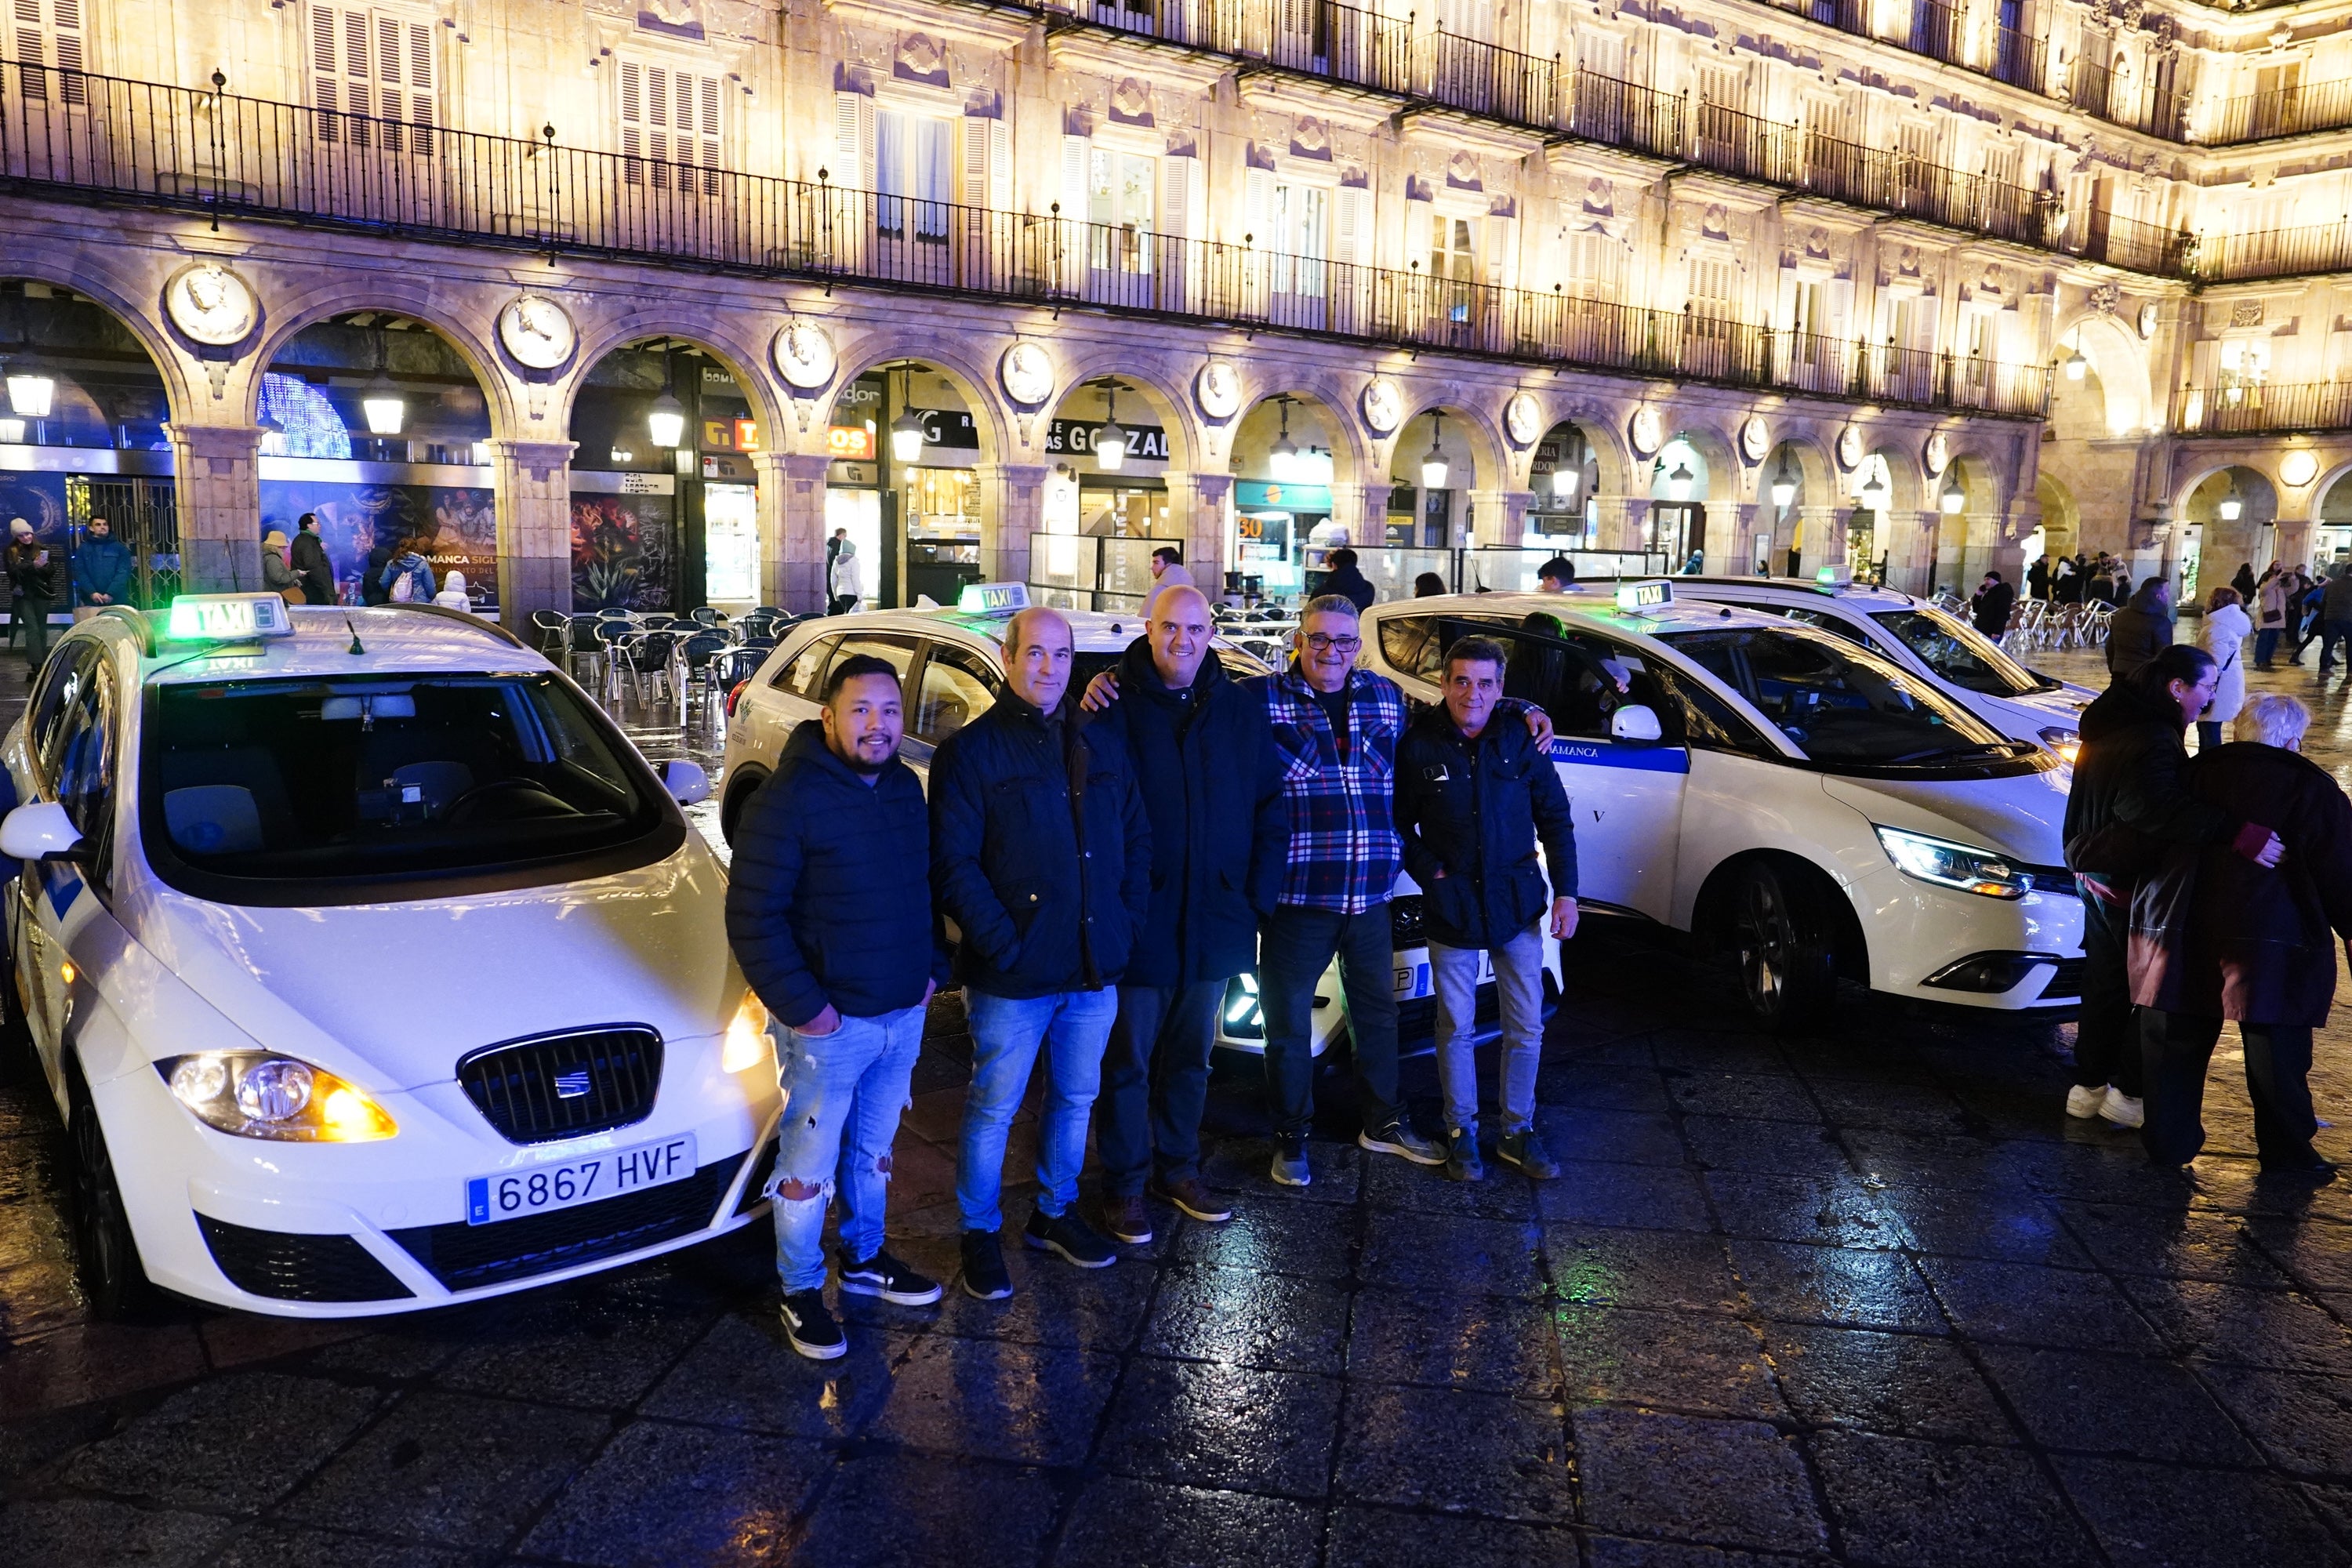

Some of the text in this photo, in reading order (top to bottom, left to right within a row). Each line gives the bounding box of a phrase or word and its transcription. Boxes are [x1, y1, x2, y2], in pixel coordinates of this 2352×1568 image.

[1239, 517, 1263, 539] 30
[471, 555, 499, 564] SIGL
[982, 587, 1012, 608] TAXI
[1637, 585, 1663, 605] TAXI
[198, 602, 252, 630] TAXI
[474, 1141, 685, 1217] E 6867 HVF
